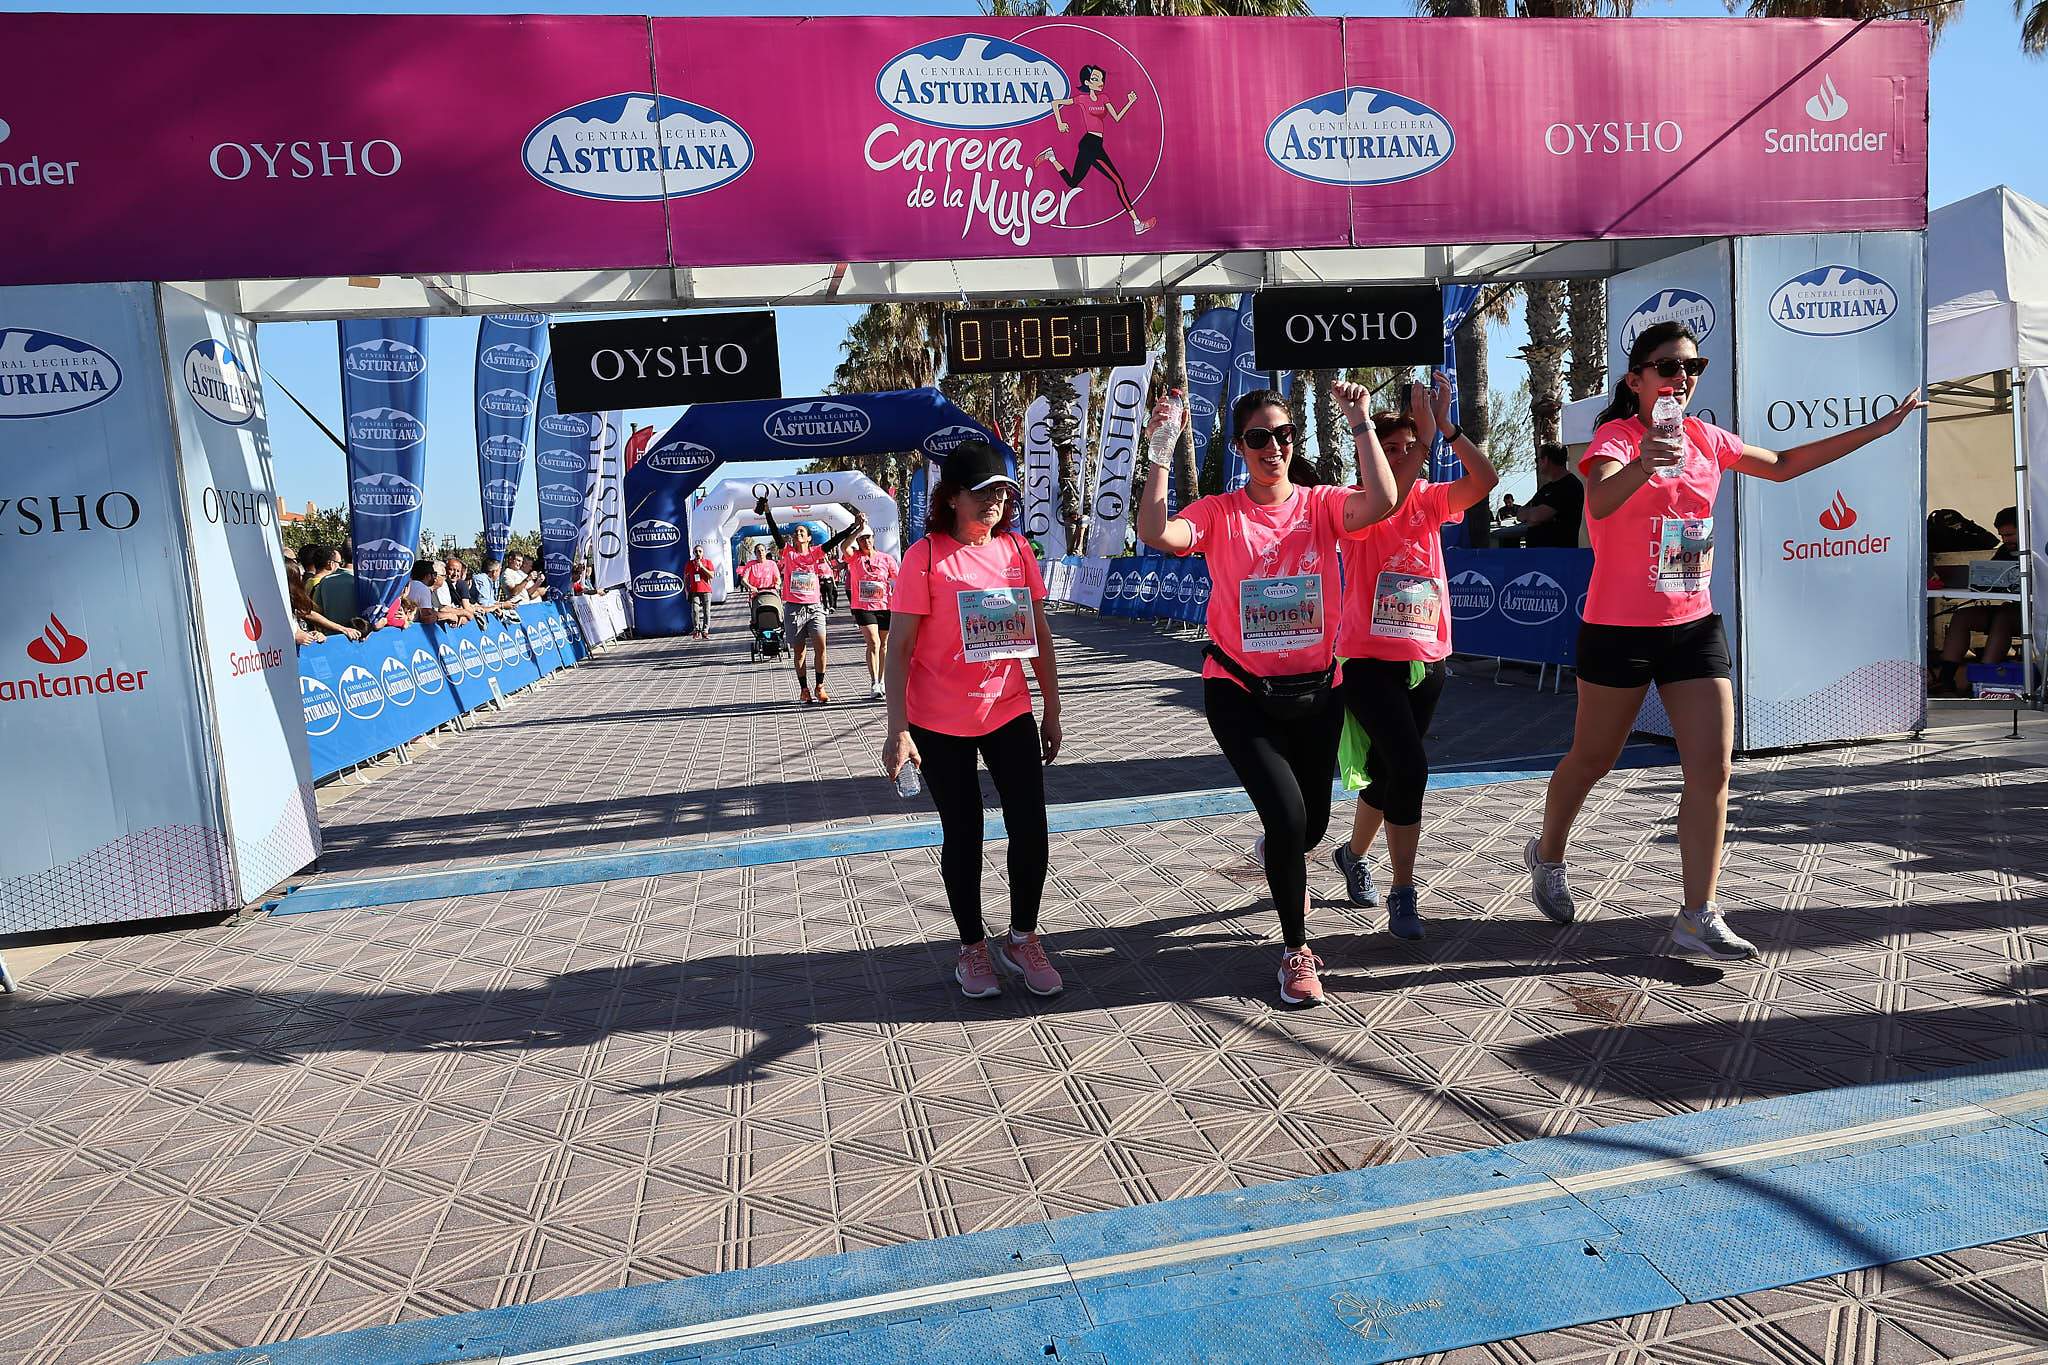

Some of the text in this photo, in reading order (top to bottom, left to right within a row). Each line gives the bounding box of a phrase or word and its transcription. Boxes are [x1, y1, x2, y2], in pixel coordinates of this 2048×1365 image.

[921, 66, 1048, 76] CENTRAL LECHERA
[893, 68, 1054, 105] ASTURIANA
[575, 128, 728, 142] CENTRAL LECHERA
[1308, 120, 1433, 131] CENTRAL LECHERA
[1543, 120, 1683, 155] OYSHO
[864, 122, 1024, 172] Carrera
[1280, 123, 1440, 160] ASTURIANA
[1765, 127, 1888, 154] Santander
[209, 139, 402, 180] OYSHO
[542, 134, 738, 173] ASTURIANA
[906, 166, 1083, 247] de la Mujer
[1797, 287, 1884, 299] CENTRAL LECHERA
[1777, 293, 1888, 320] ASTURIANA
[1284, 310, 1418, 344] OYSHO
[1191, 332, 1228, 351] ASTURIANA
[32, 356, 98, 368] LECHERA
[347, 353, 419, 373] ASTURIANA
[590, 343, 748, 381] OYSHO
[192, 361, 253, 409] ASTURIANA
[1187, 368, 1220, 382] STURIANA
[1767, 391, 1898, 432] OYSHO
[772, 417, 864, 437] ASTURIANA
[651, 455, 710, 467] ASTURIANA
[1096, 379, 1142, 522] OYSHO
[752, 479, 834, 499] OYSHO
[1029, 421, 1052, 537] OYSHO
[202, 486, 271, 527] OYSHO
[703, 502, 730, 512] OYSHO
[631, 530, 678, 543] ASTURIANA
[1782, 534, 1891, 581] Santander
[634, 583, 681, 594] ASTURIANA
[1449, 594, 1490, 609] STURIANA
[1503, 590, 1560, 614] ASTURIANA
[987, 618, 1015, 633] 016
[1267, 608, 1299, 623] 016
[230, 648, 283, 677] Santander
[343, 688, 384, 710] ASTURIANA
